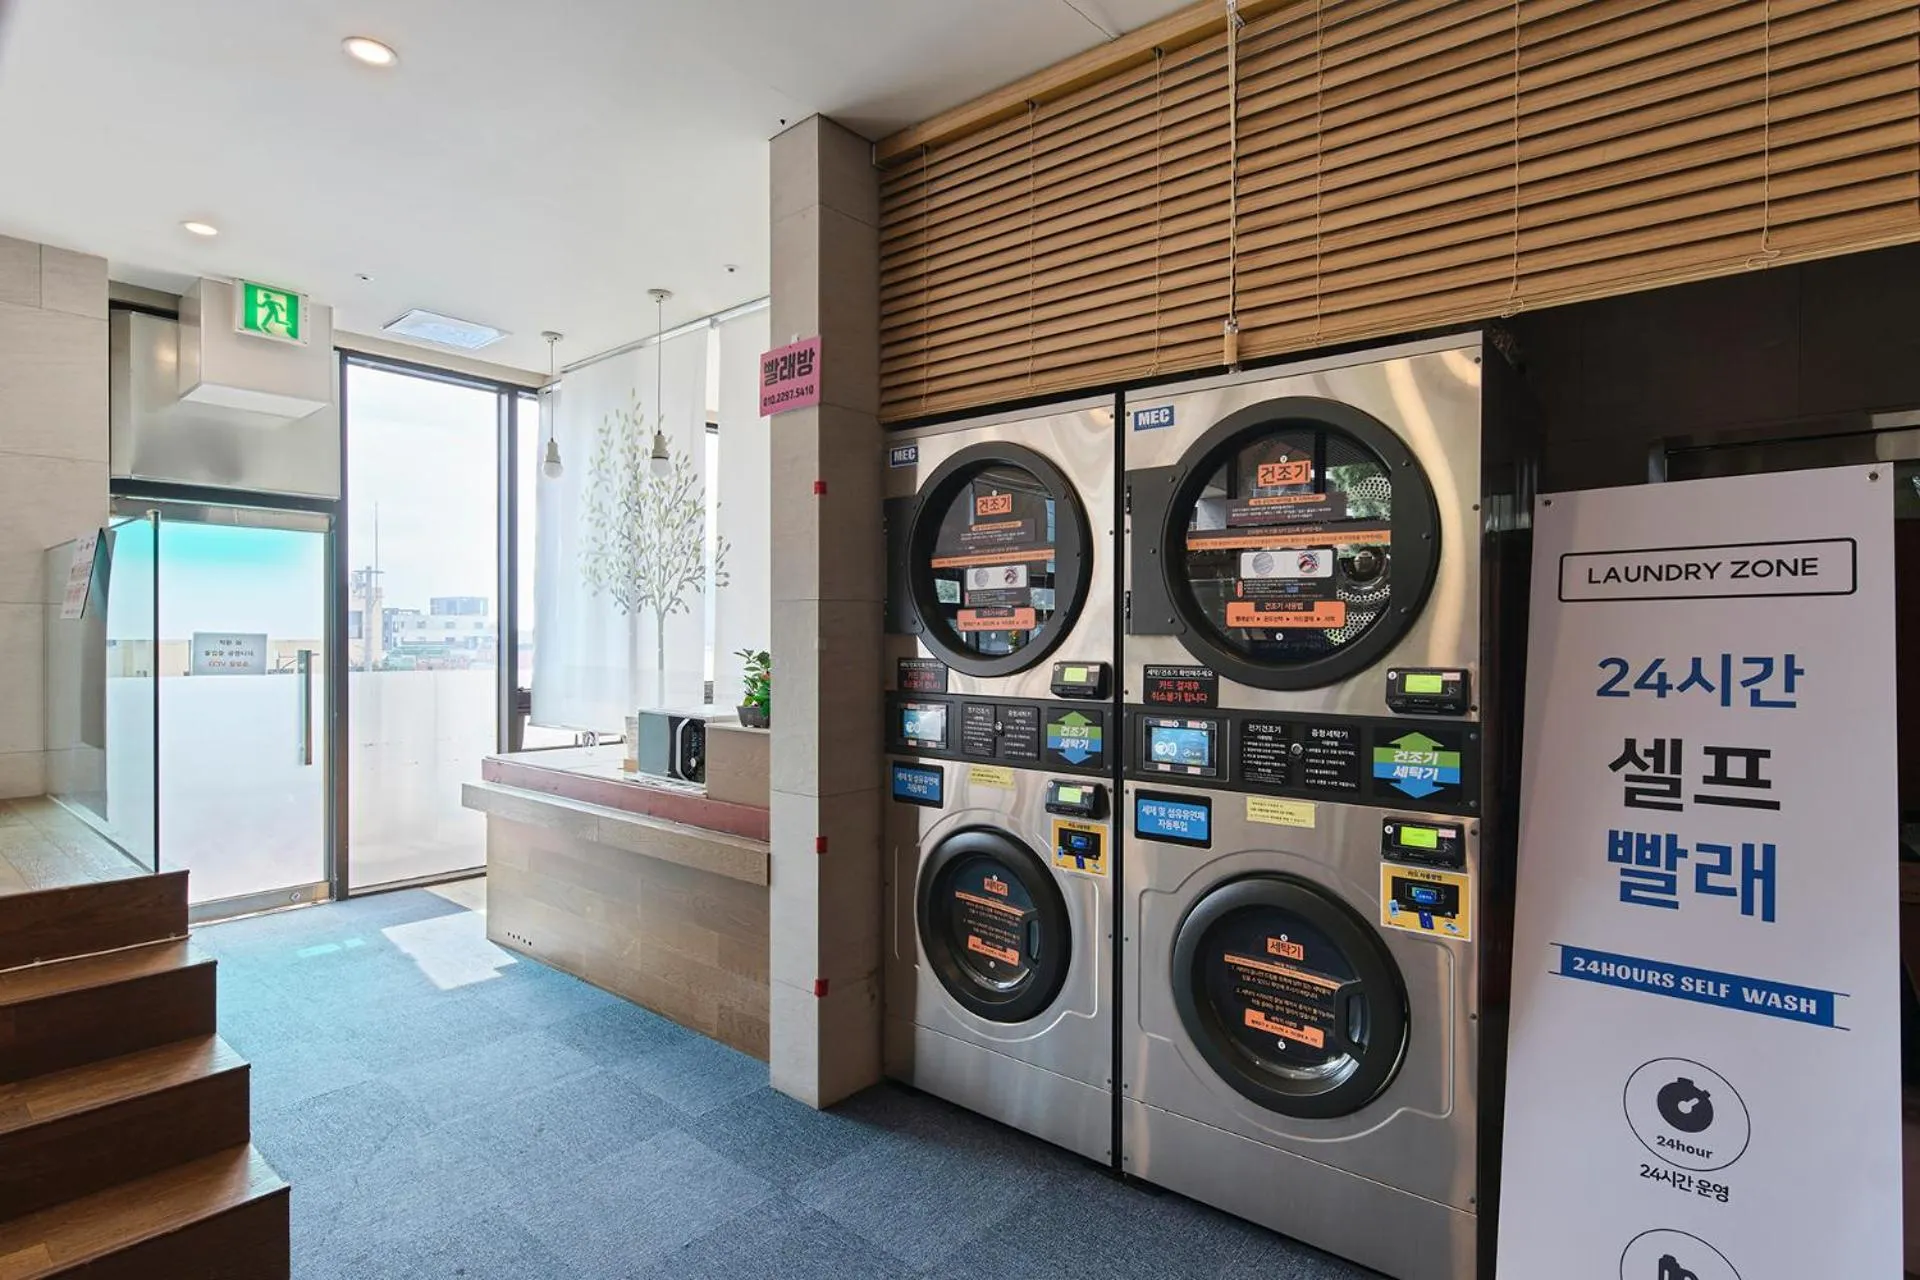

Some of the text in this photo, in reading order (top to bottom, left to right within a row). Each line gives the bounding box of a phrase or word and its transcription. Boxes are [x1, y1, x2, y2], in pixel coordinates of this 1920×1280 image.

[764, 347, 815, 387] 빨래방
[1138, 408, 1170, 426] MEC
[894, 447, 916, 463] MEC
[1261, 461, 1309, 485] 건조기
[979, 497, 1011, 514] 건조기
[1588, 557, 1819, 585] LAUNDRY ZONE
[1596, 653, 1805, 709] 24시간
[1061, 726, 1089, 738] 건조기
[1394, 750, 1439, 765] 건조기
[1393, 765, 1439, 781] 세탁기
[1608, 738, 1781, 813] 셀프
[1608, 829, 1776, 923] 빨래
[1270, 940, 1303, 960] 세탁기
[1572, 956, 1817, 1016] 24HOURS SELF WASH
[1656, 1135, 1713, 1160] 24hour
[1639, 1163, 1729, 1203] 24시간 운영
